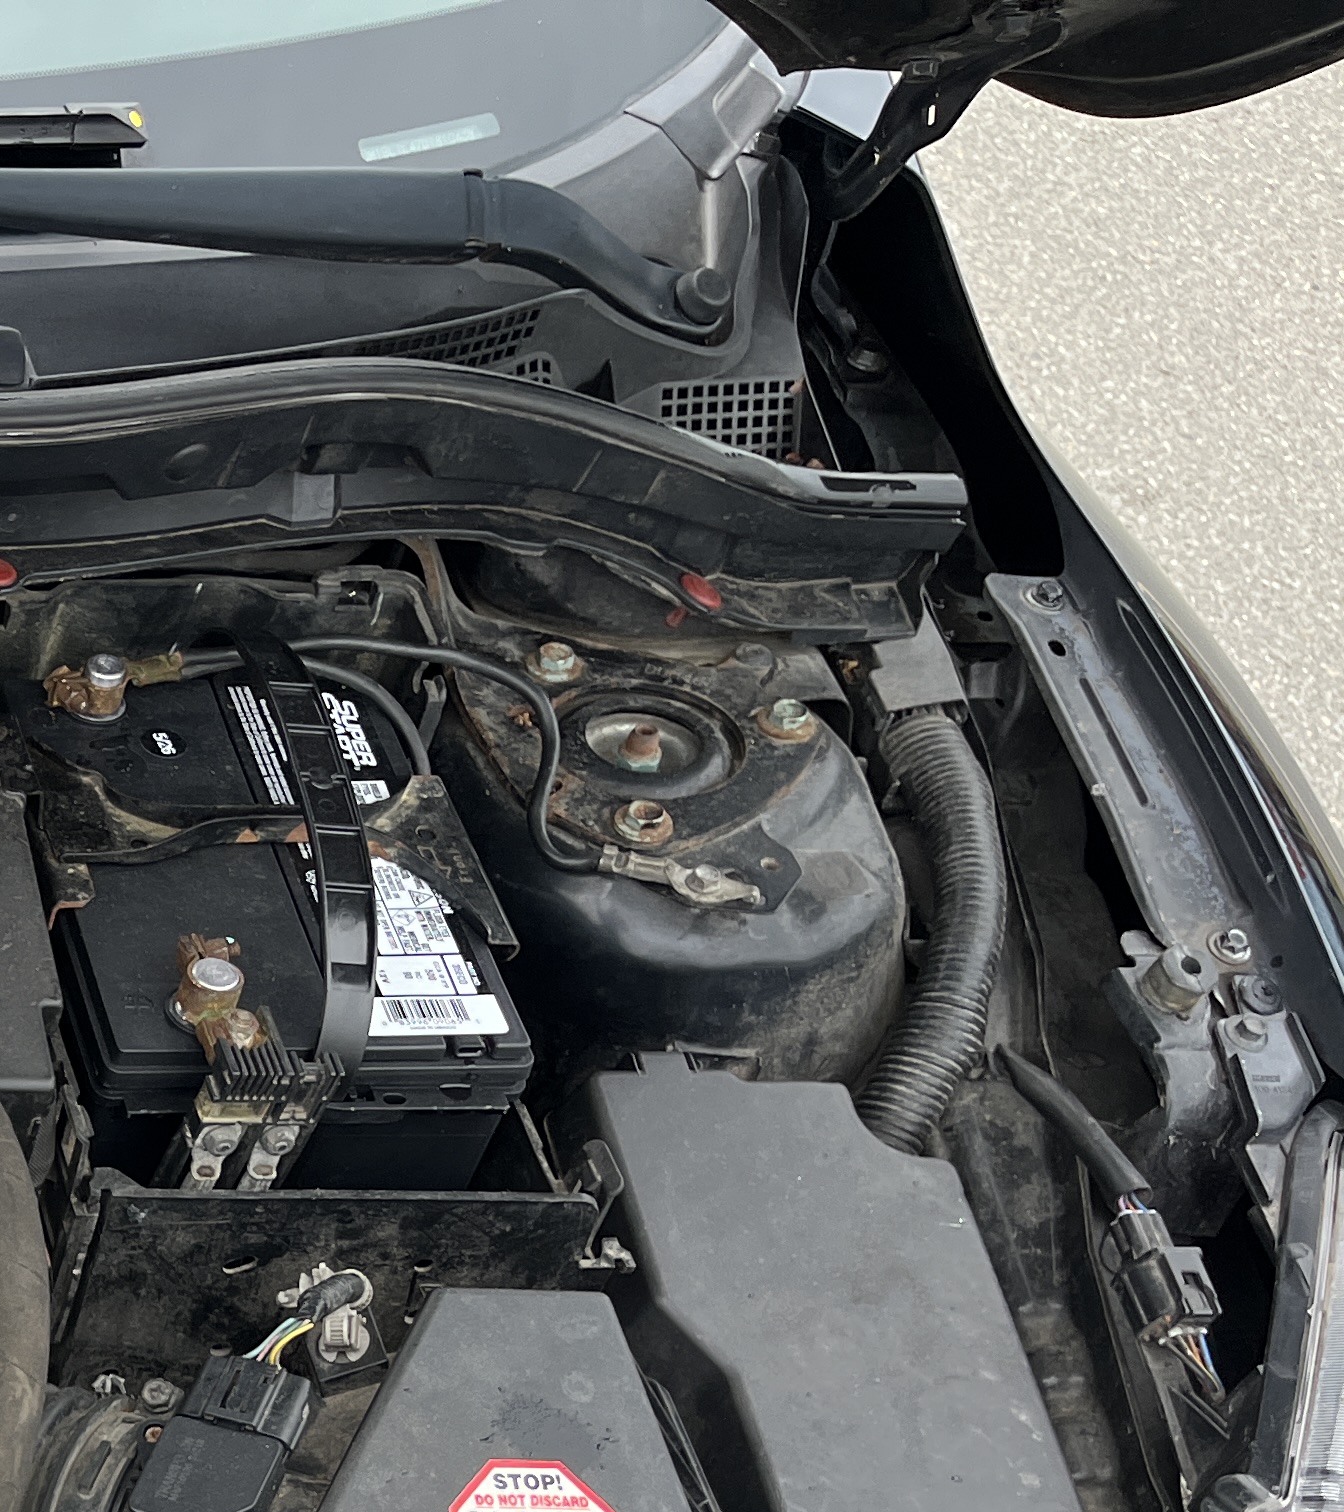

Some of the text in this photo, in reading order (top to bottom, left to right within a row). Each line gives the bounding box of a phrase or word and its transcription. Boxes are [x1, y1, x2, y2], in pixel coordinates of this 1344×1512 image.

[338, 701, 377, 766] SUPER
[493, 1474, 563, 1490] STOP!
[475, 1494, 589, 1508] DO NOT DISCARD
